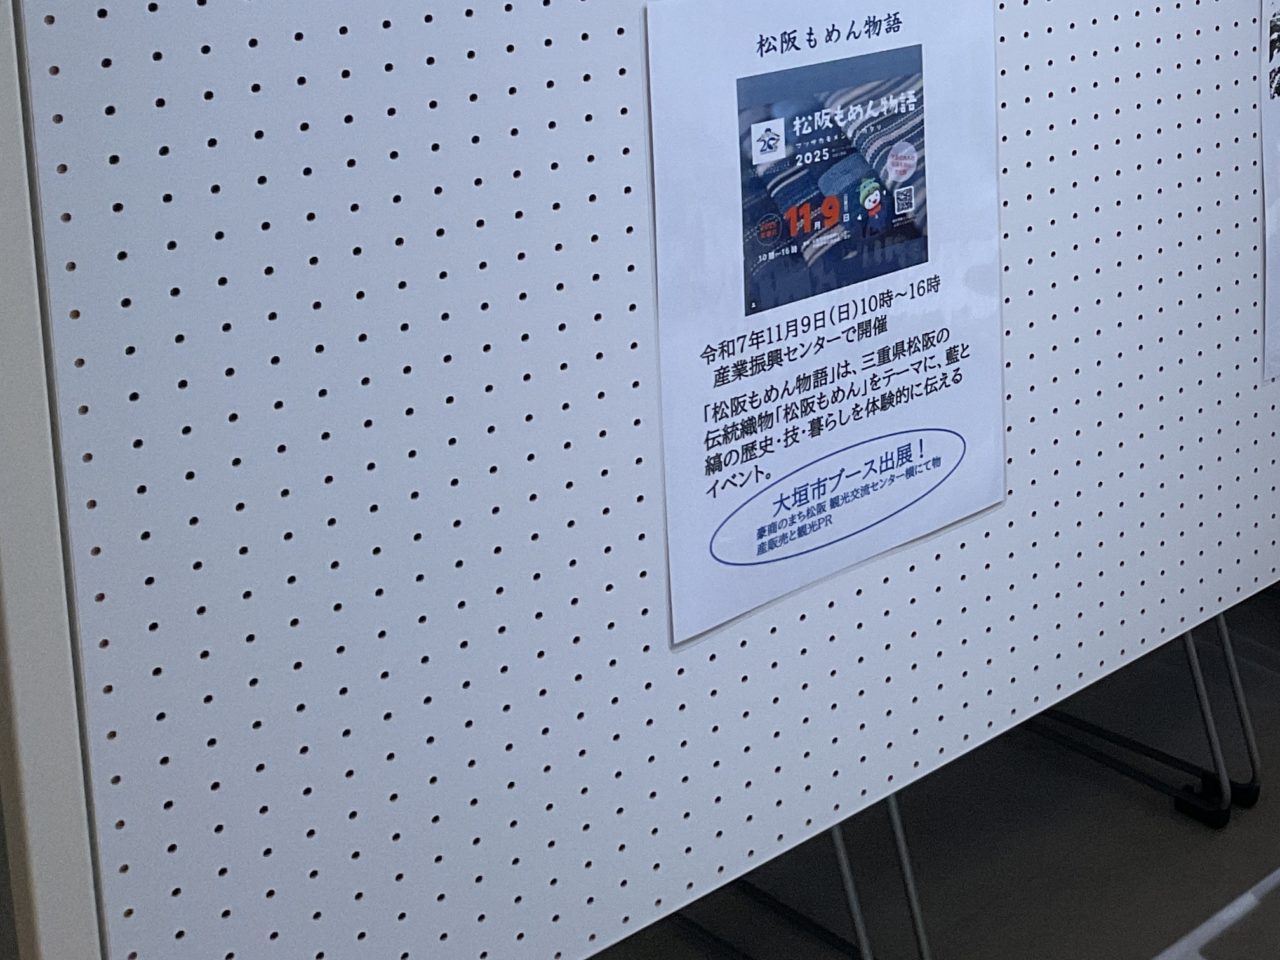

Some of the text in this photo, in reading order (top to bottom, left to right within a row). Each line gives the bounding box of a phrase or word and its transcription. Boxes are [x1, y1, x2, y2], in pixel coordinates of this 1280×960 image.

[755, 11, 903, 58] 松阪もめん物語
[792, 90, 918, 137] 松阪もめん物語
[795, 147, 831, 167] 2025
[703, 327, 951, 424] 「松阪もめん物語」は、三重県松阪の
[713, 315, 889, 389] 産業振興センターで開催
[703, 342, 971, 452] 伝統織物「松阪もめん」をテーマに、藍と
[704, 367, 964, 477] 縞の歴史・技・暮らしを体験的に伝える
[705, 464, 772, 500] イベント。
[755, 500, 828, 541] 豪商のまち松阪
